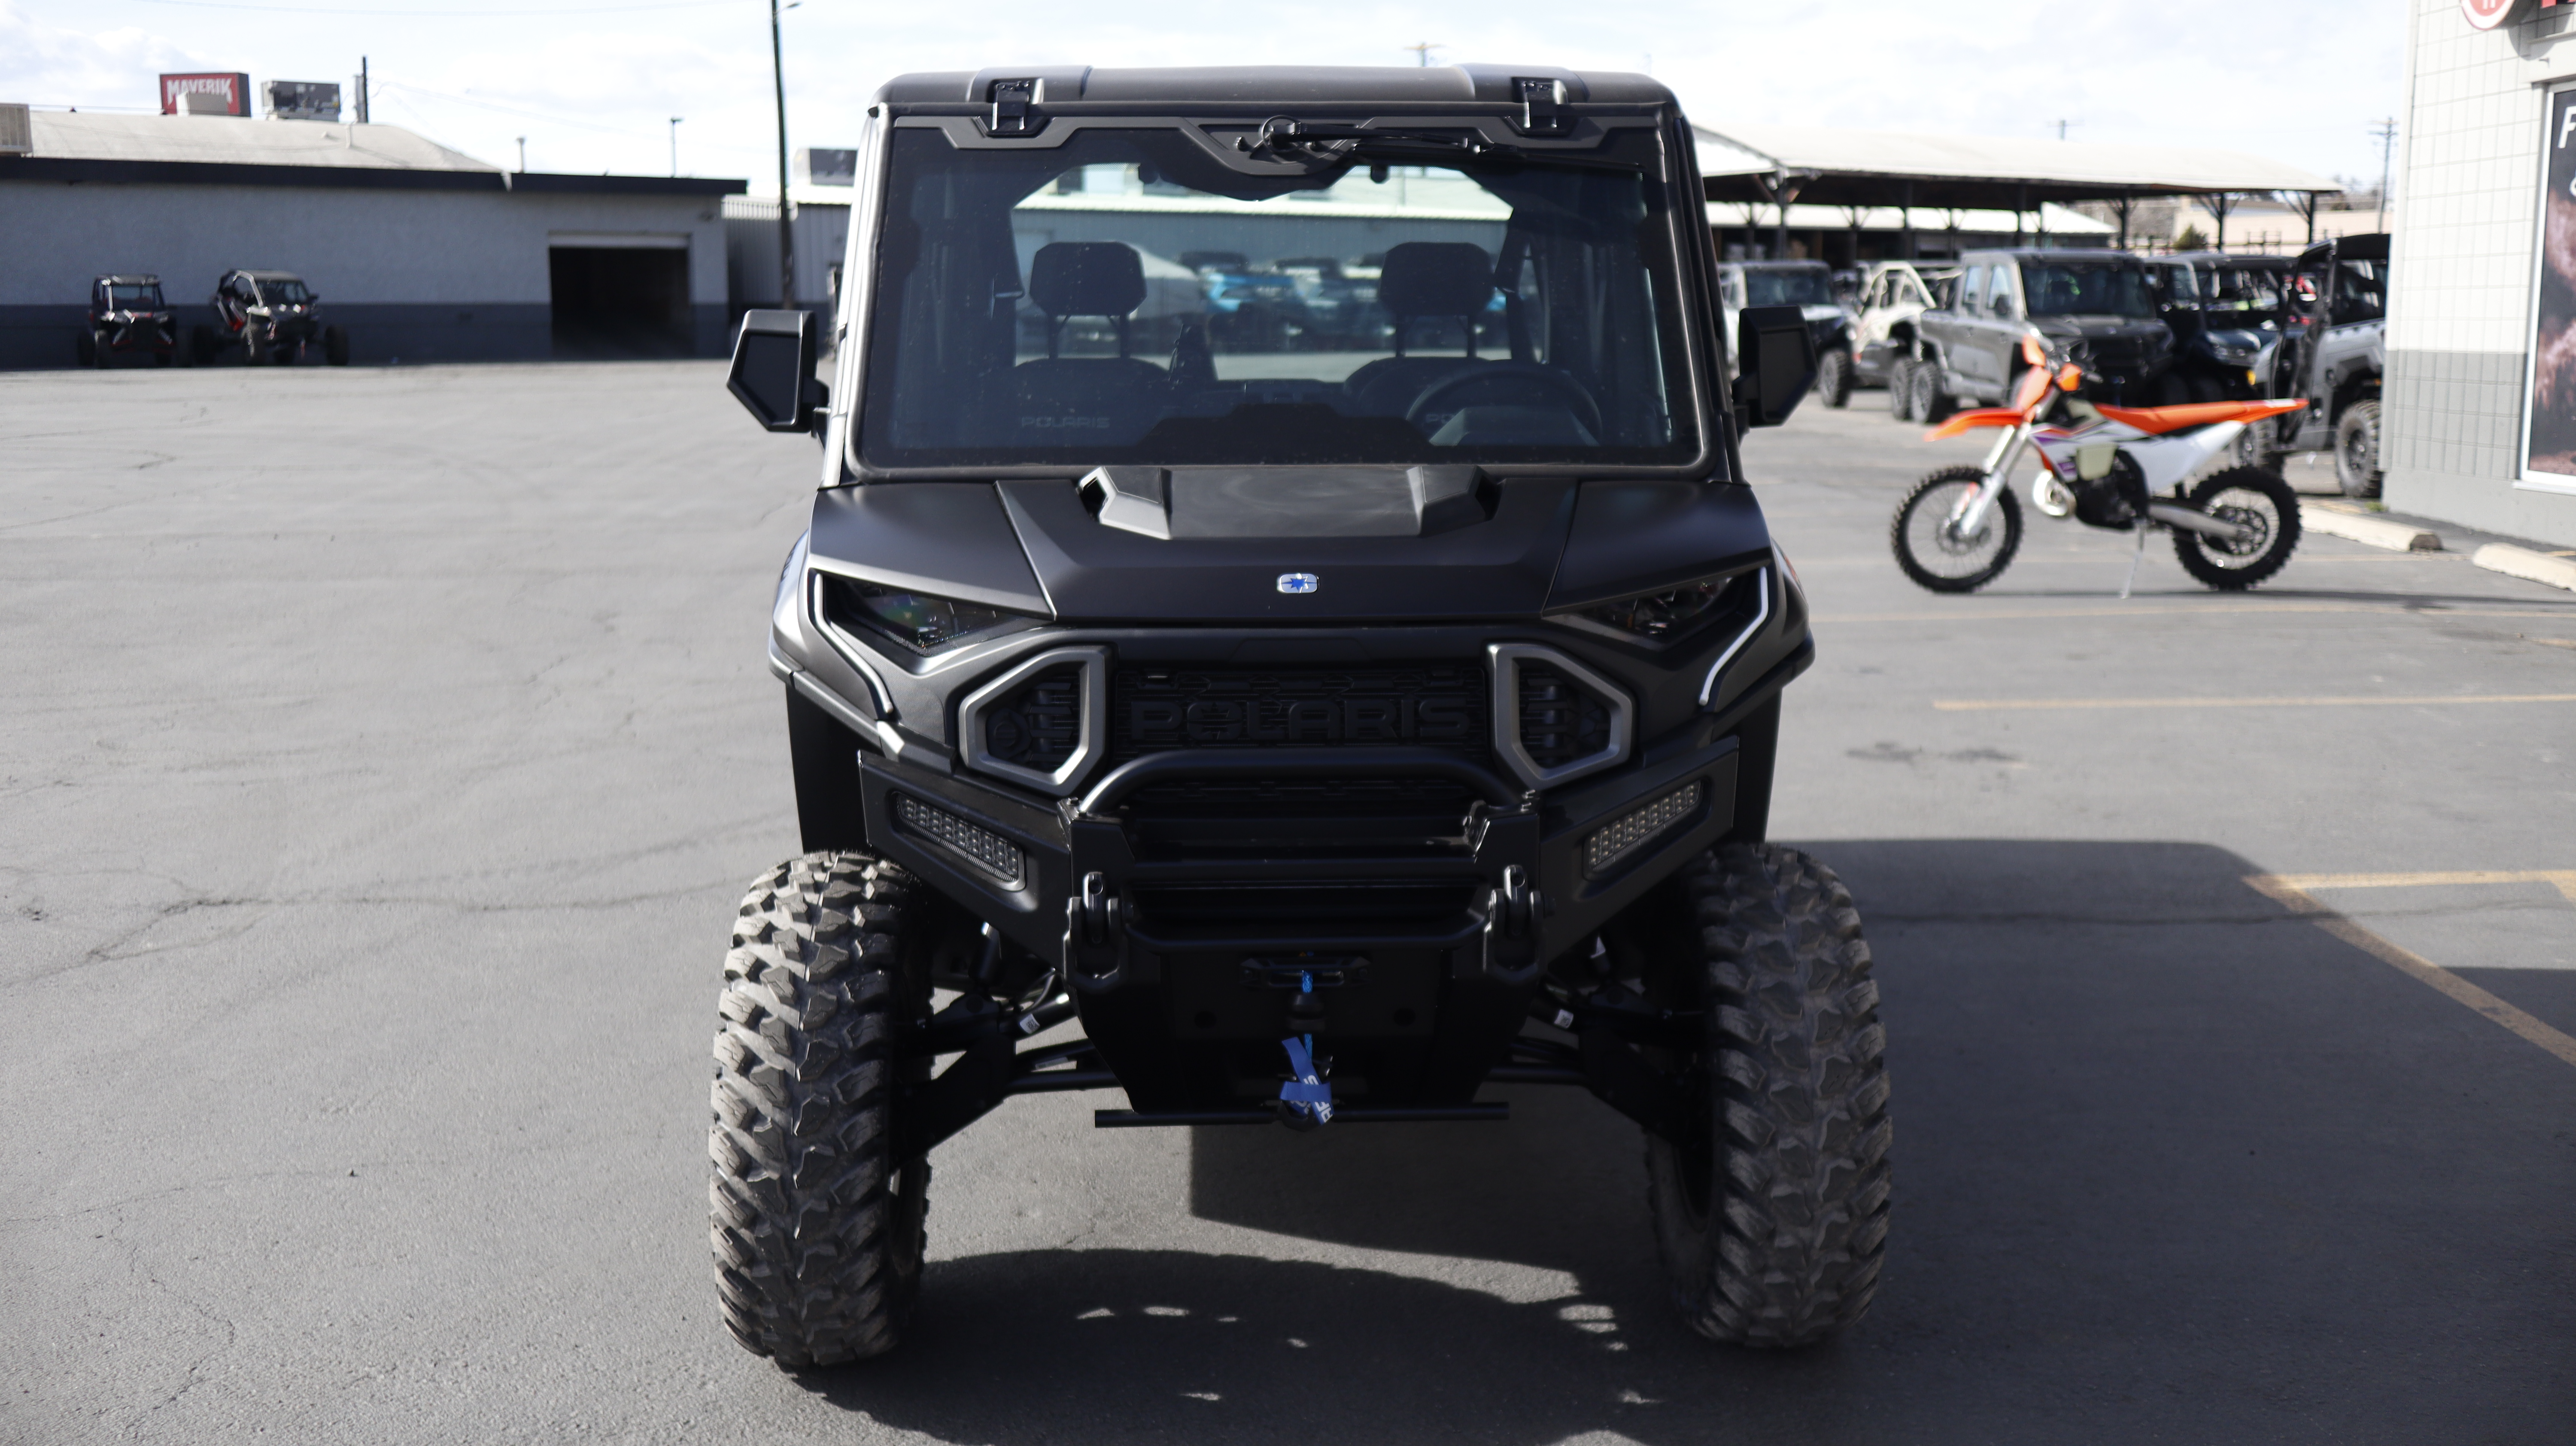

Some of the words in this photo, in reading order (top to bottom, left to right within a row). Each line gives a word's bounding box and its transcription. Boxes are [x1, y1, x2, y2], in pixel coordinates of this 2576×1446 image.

[167, 78, 233, 106] MAVERIK
[1021, 416, 1110, 428] POLARIS
[1130, 699, 1470, 741] POLARIS
